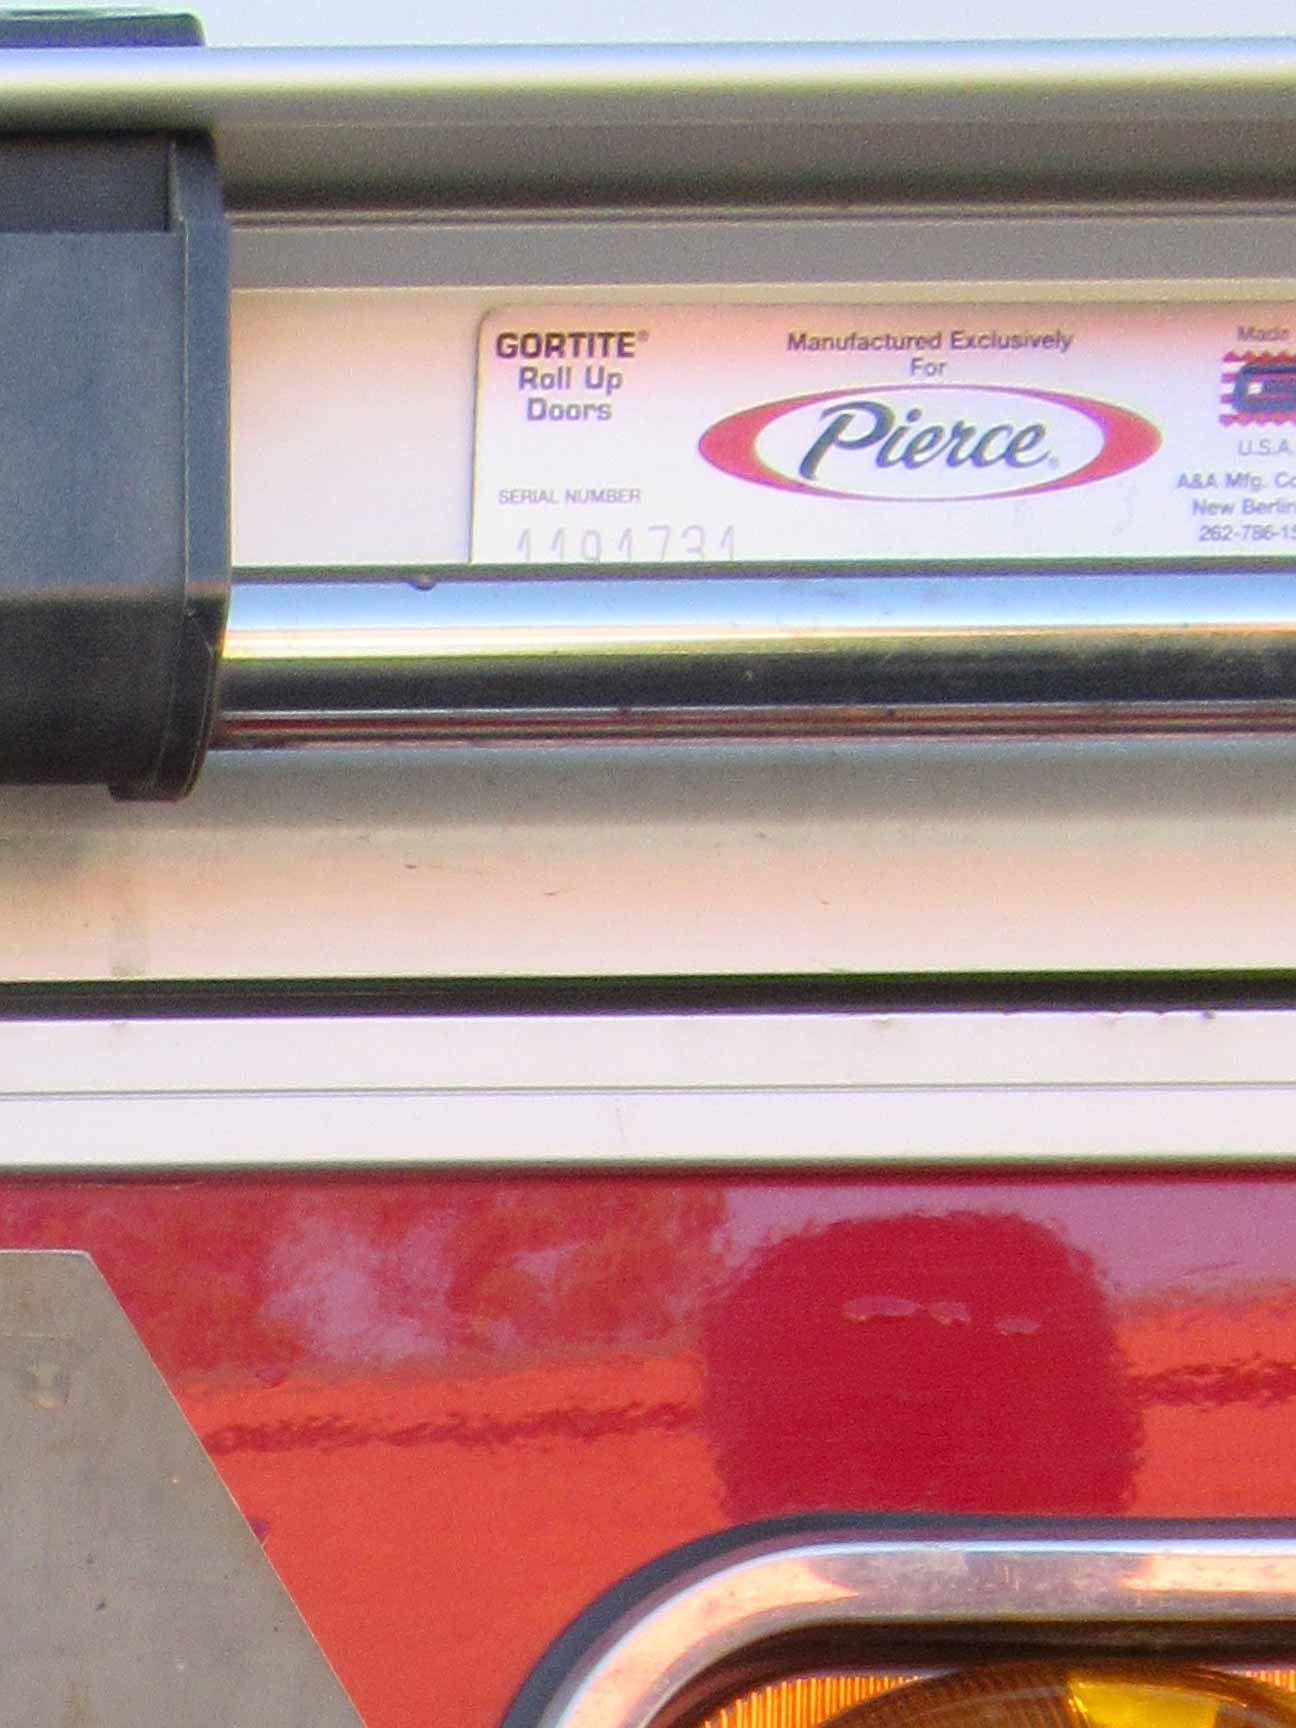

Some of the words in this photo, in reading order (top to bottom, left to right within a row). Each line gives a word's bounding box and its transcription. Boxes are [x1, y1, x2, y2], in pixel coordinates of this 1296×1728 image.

[787, 331, 943, 351] Manufactured
[950, 330, 1074, 353] Exclusively
[1238, 326, 1289, 342] Made
[909, 357, 949, 378] For
[518, 365, 572, 391] Roll
[585, 365, 624, 396] Up
[526, 397, 613, 421] Doors
[799, 400, 1051, 480] Pierce
[1177, 473, 1218, 489] A&A
[1225, 472, 1267, 492] Mfg.
[497, 488, 558, 505] SERIAL
[565, 488, 641, 503] NUMBER
[1192, 498, 1234, 516] New
